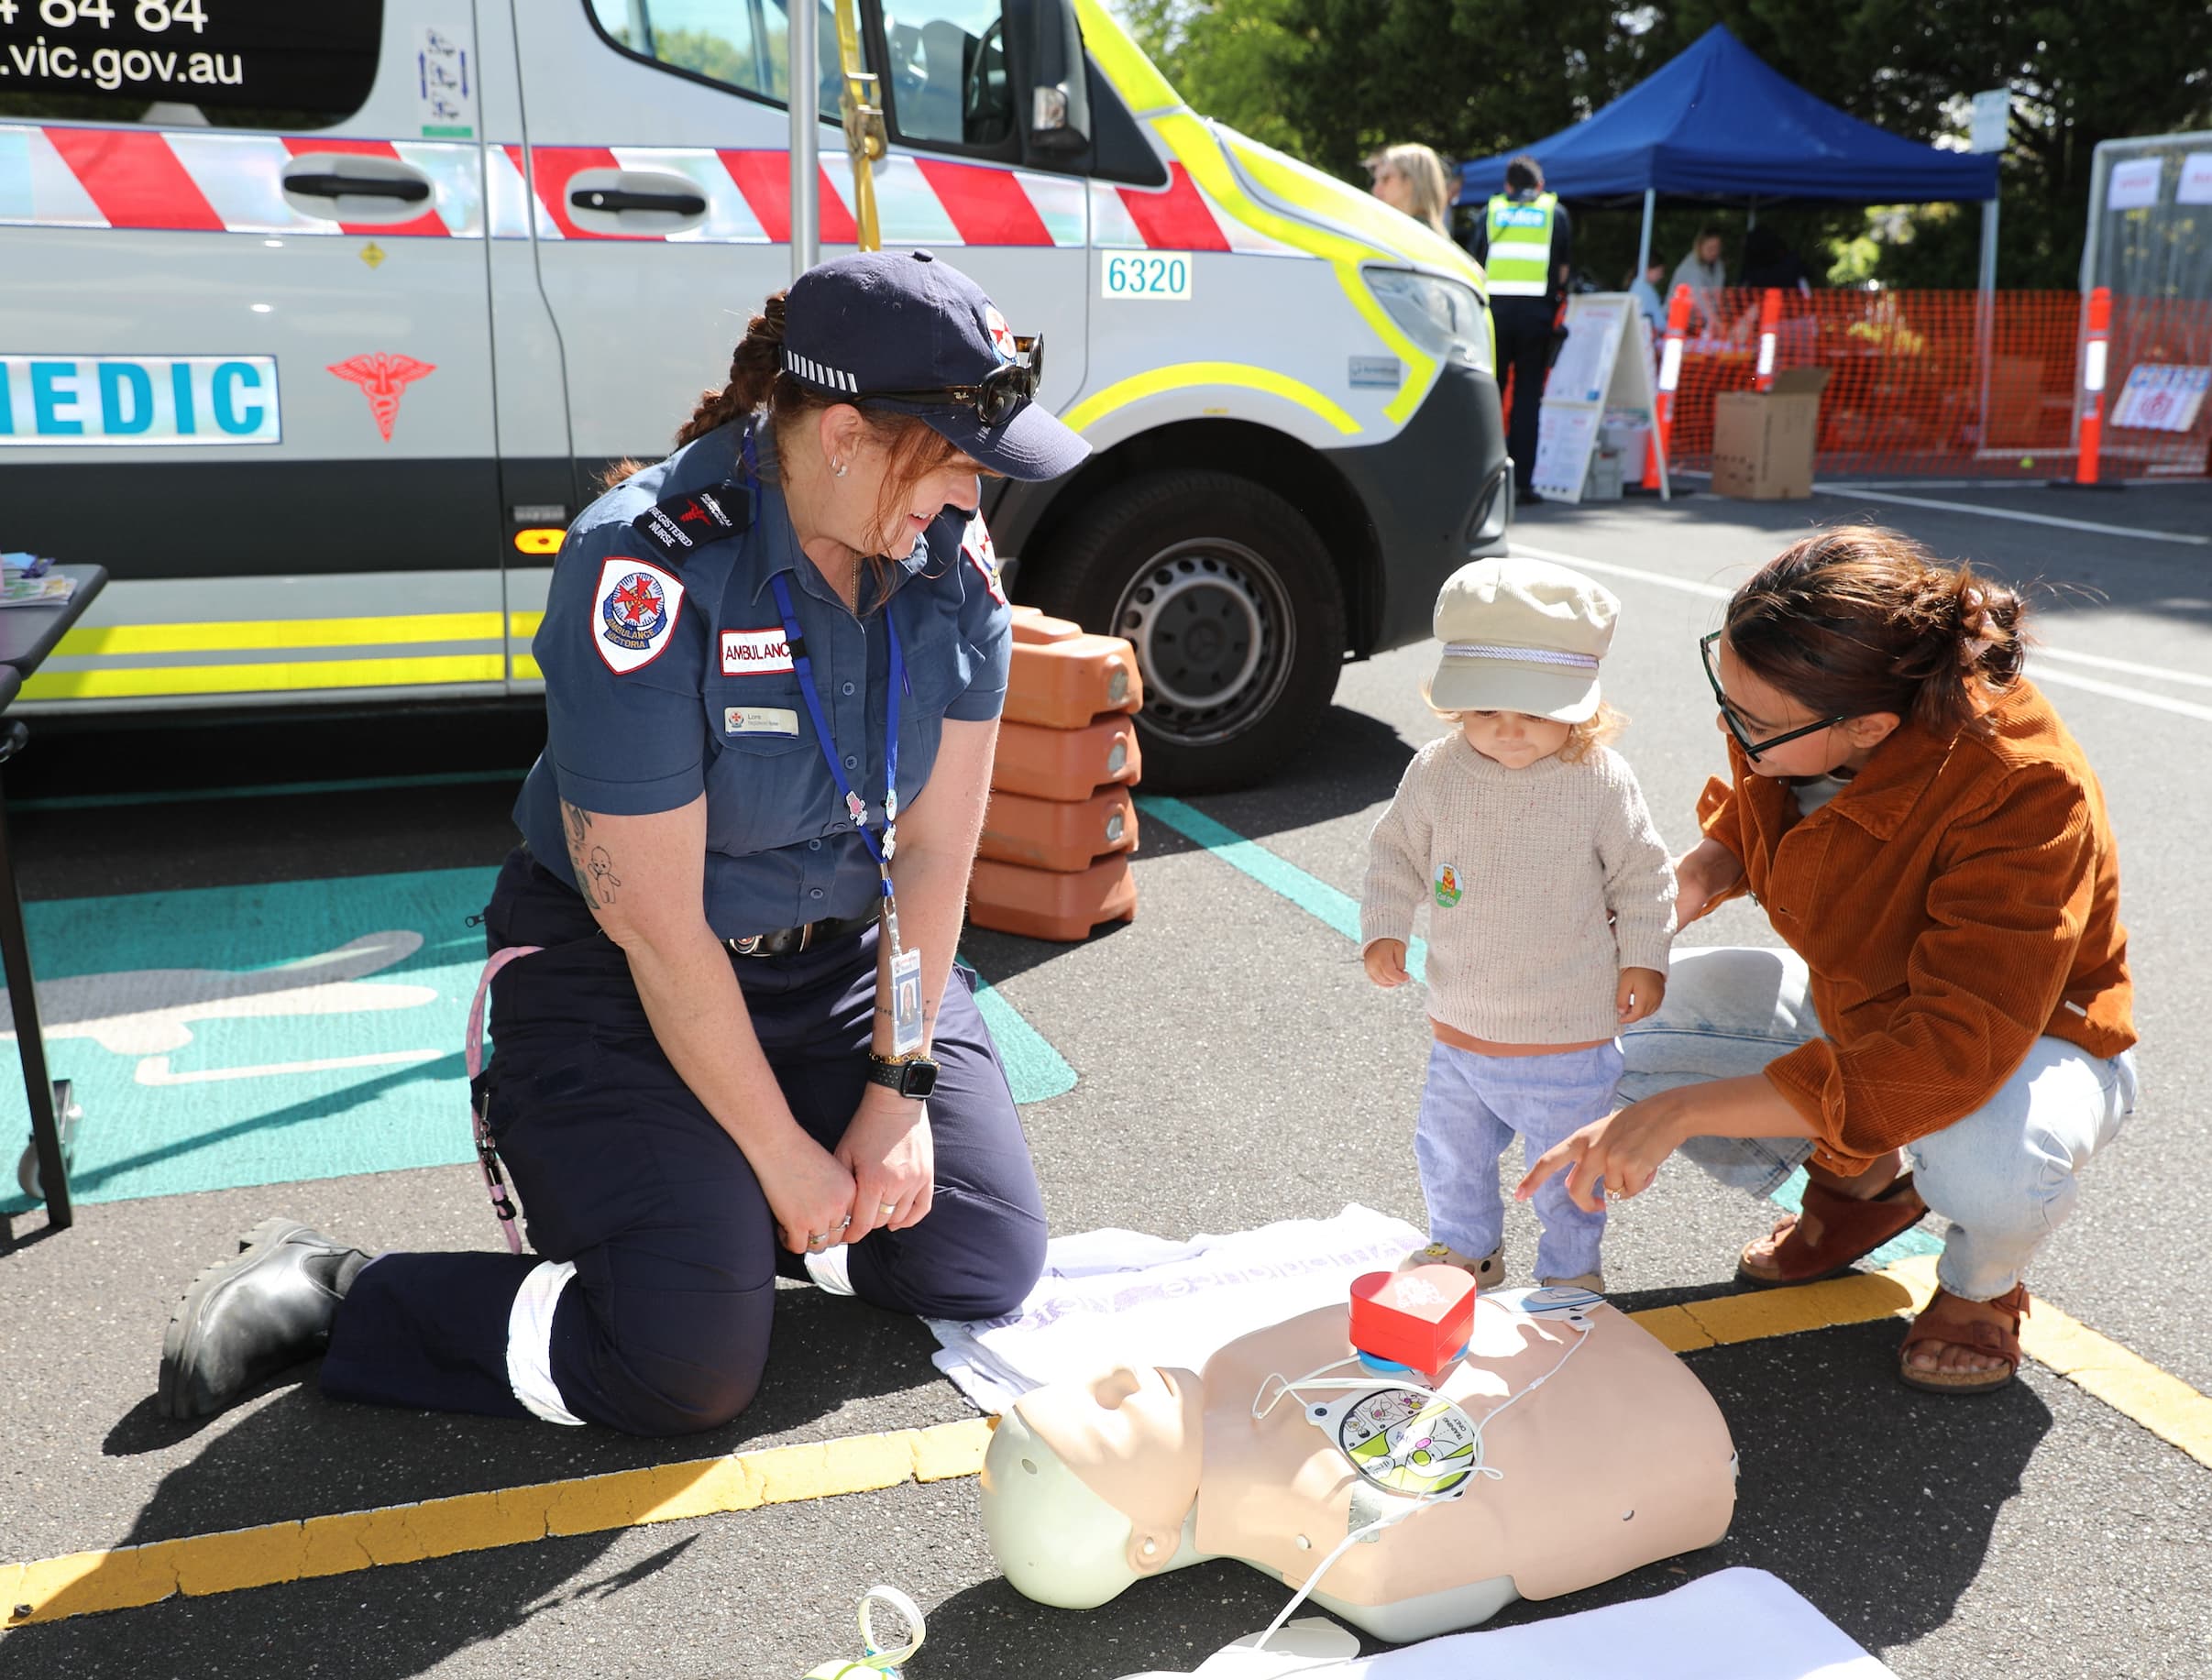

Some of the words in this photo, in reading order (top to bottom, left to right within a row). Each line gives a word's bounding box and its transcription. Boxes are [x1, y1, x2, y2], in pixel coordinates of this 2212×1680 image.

[1109, 258, 1185, 293] 6320
[0, 361, 264, 434] EDIC
[648, 506, 694, 547] REGISTERED
[648, 521, 677, 548] NURSE
[606, 618, 655, 641] AMBULANCE
[607, 631, 646, 649] VICTORIA
[725, 642, 791, 661] AMBULANC
[1442, 1417, 1463, 1440] TRAINING
[1453, 1418, 1467, 1432] ONLY
